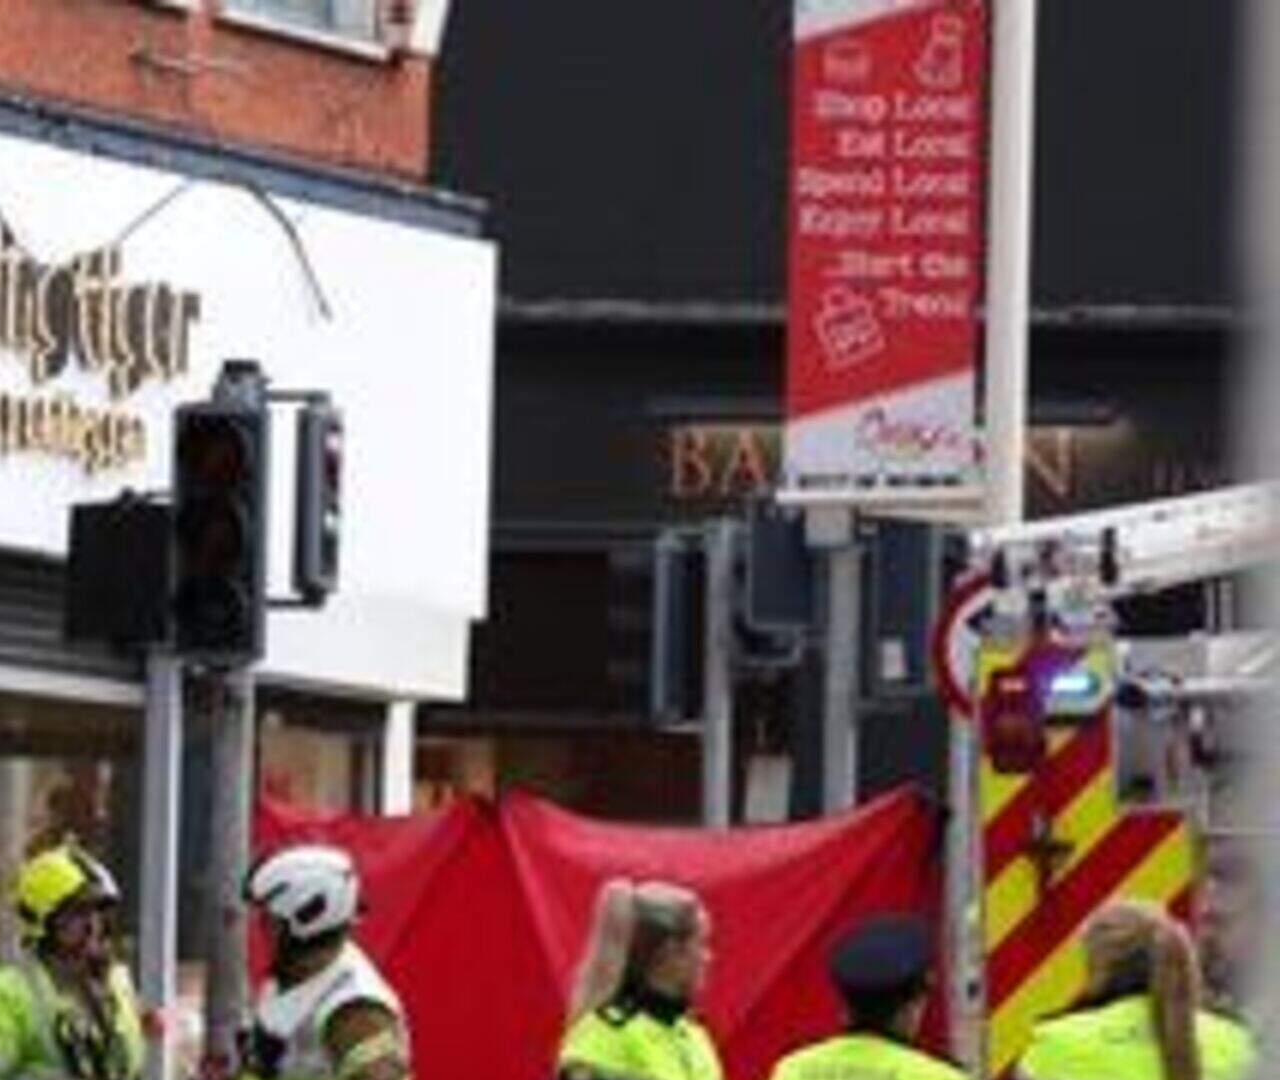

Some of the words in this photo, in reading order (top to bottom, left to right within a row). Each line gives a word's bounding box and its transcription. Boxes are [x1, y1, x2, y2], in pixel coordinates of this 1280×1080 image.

[895, 91, 970, 120] Local
[894, 130, 970, 157] Local
[893, 167, 970, 195] Local
[891, 205, 970, 234] Local
